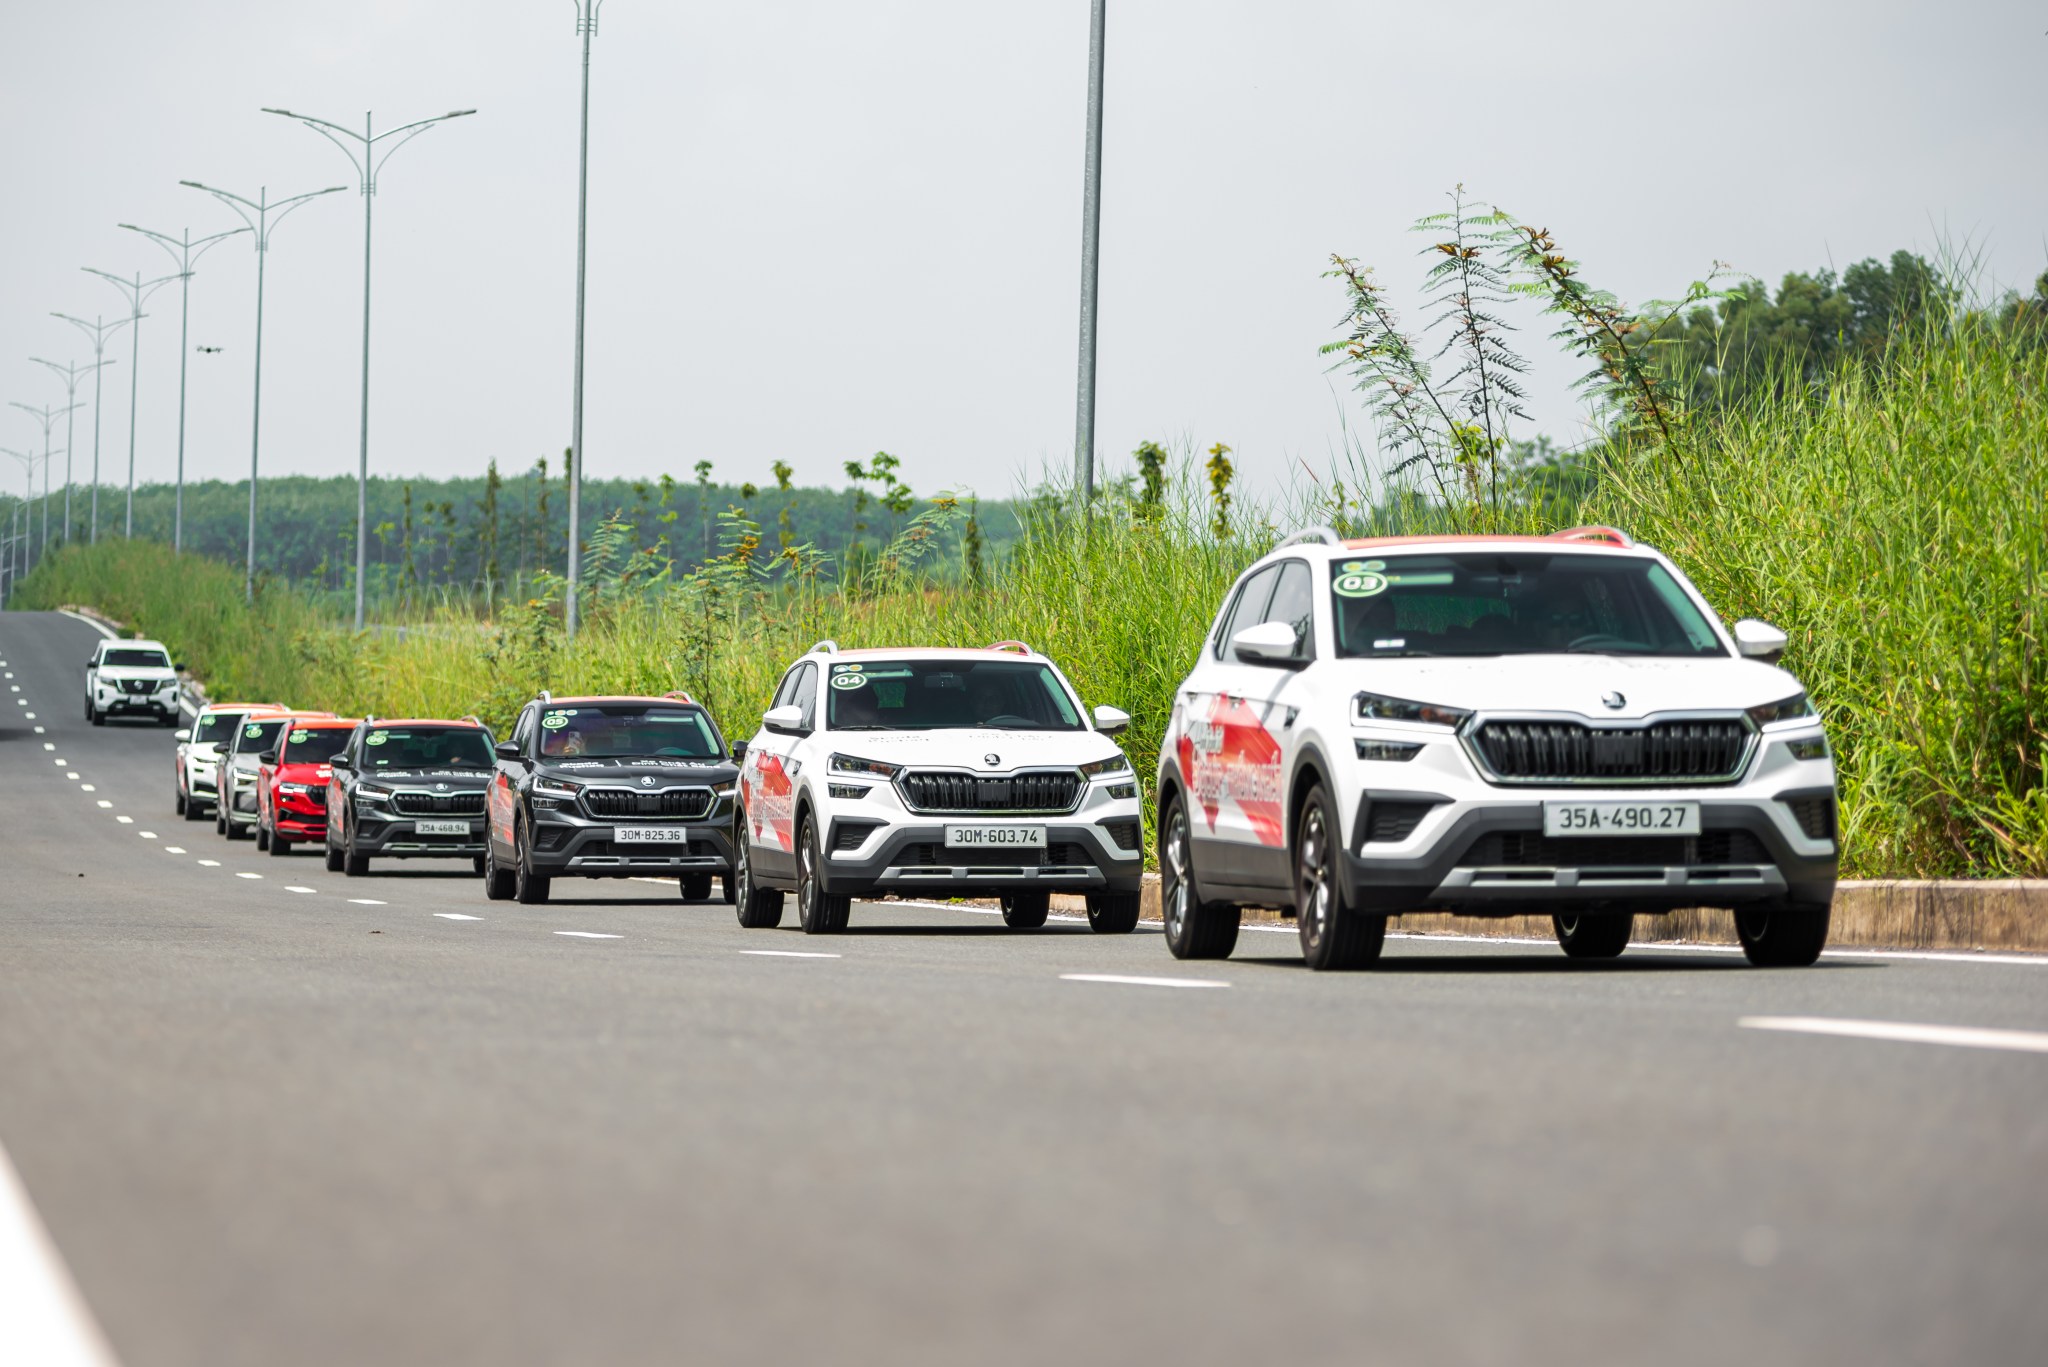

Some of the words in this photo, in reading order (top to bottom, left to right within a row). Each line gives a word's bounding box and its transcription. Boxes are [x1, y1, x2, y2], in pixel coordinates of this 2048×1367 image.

[1343, 576, 1378, 590] 03
[837, 675, 861, 686] 04
[546, 718, 564, 726] 05
[1559, 807, 1687, 829] 35A-490.27
[620, 830, 681, 841] 30M-825.36
[954, 829, 1038, 844] 30M-603.74
